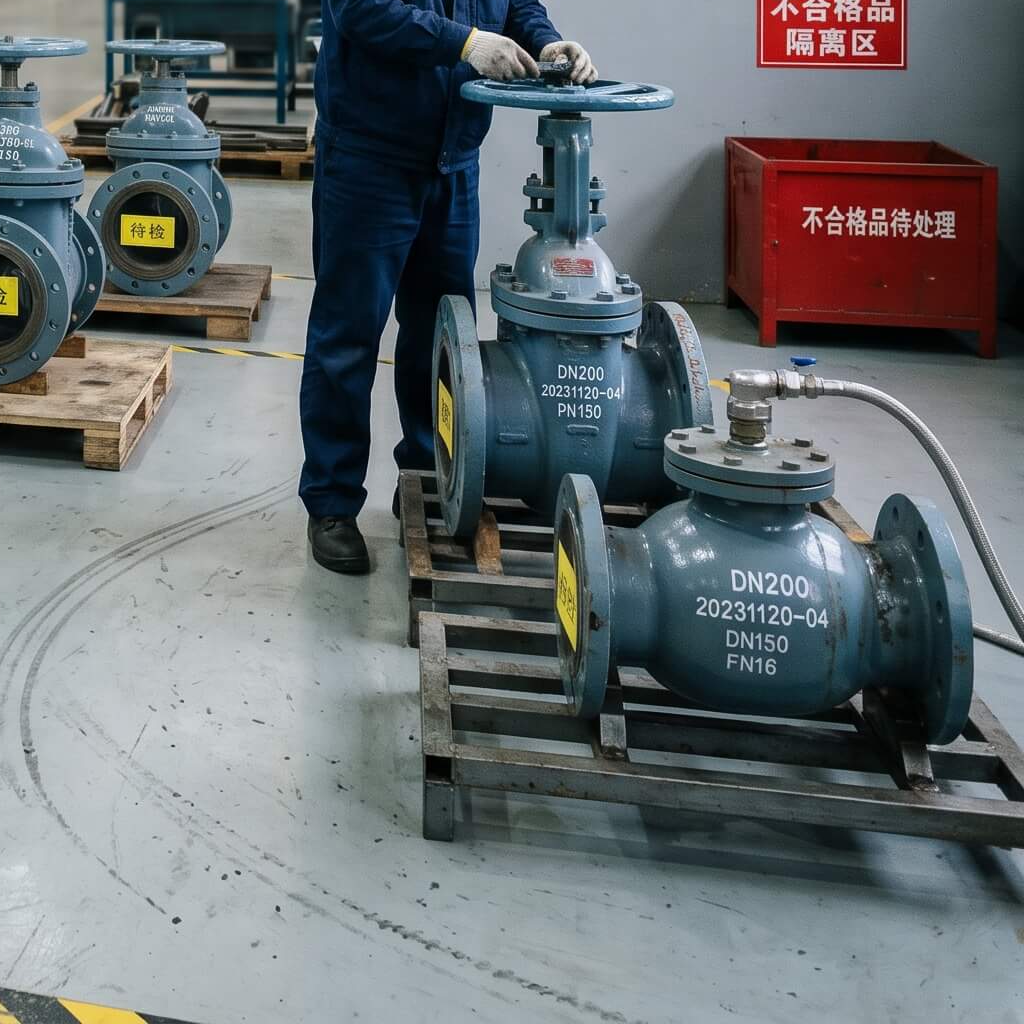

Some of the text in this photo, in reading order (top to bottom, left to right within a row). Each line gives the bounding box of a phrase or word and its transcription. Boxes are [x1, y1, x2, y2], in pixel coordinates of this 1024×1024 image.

[786, 28, 878, 57] 隔离区
[130, 222, 166, 240] 待检
[802, 205, 956, 239] 不合格品待处理
[557, 364, 604, 382] DN200
[541, 383, 621, 401] 20231120-04
[557, 403, 602, 420] PN150
[731, 569, 809, 598] DN200
[696, 597, 829, 628] 20231120-04
[726, 629, 789, 653] DN150
[726, 653, 777, 675] FN16
